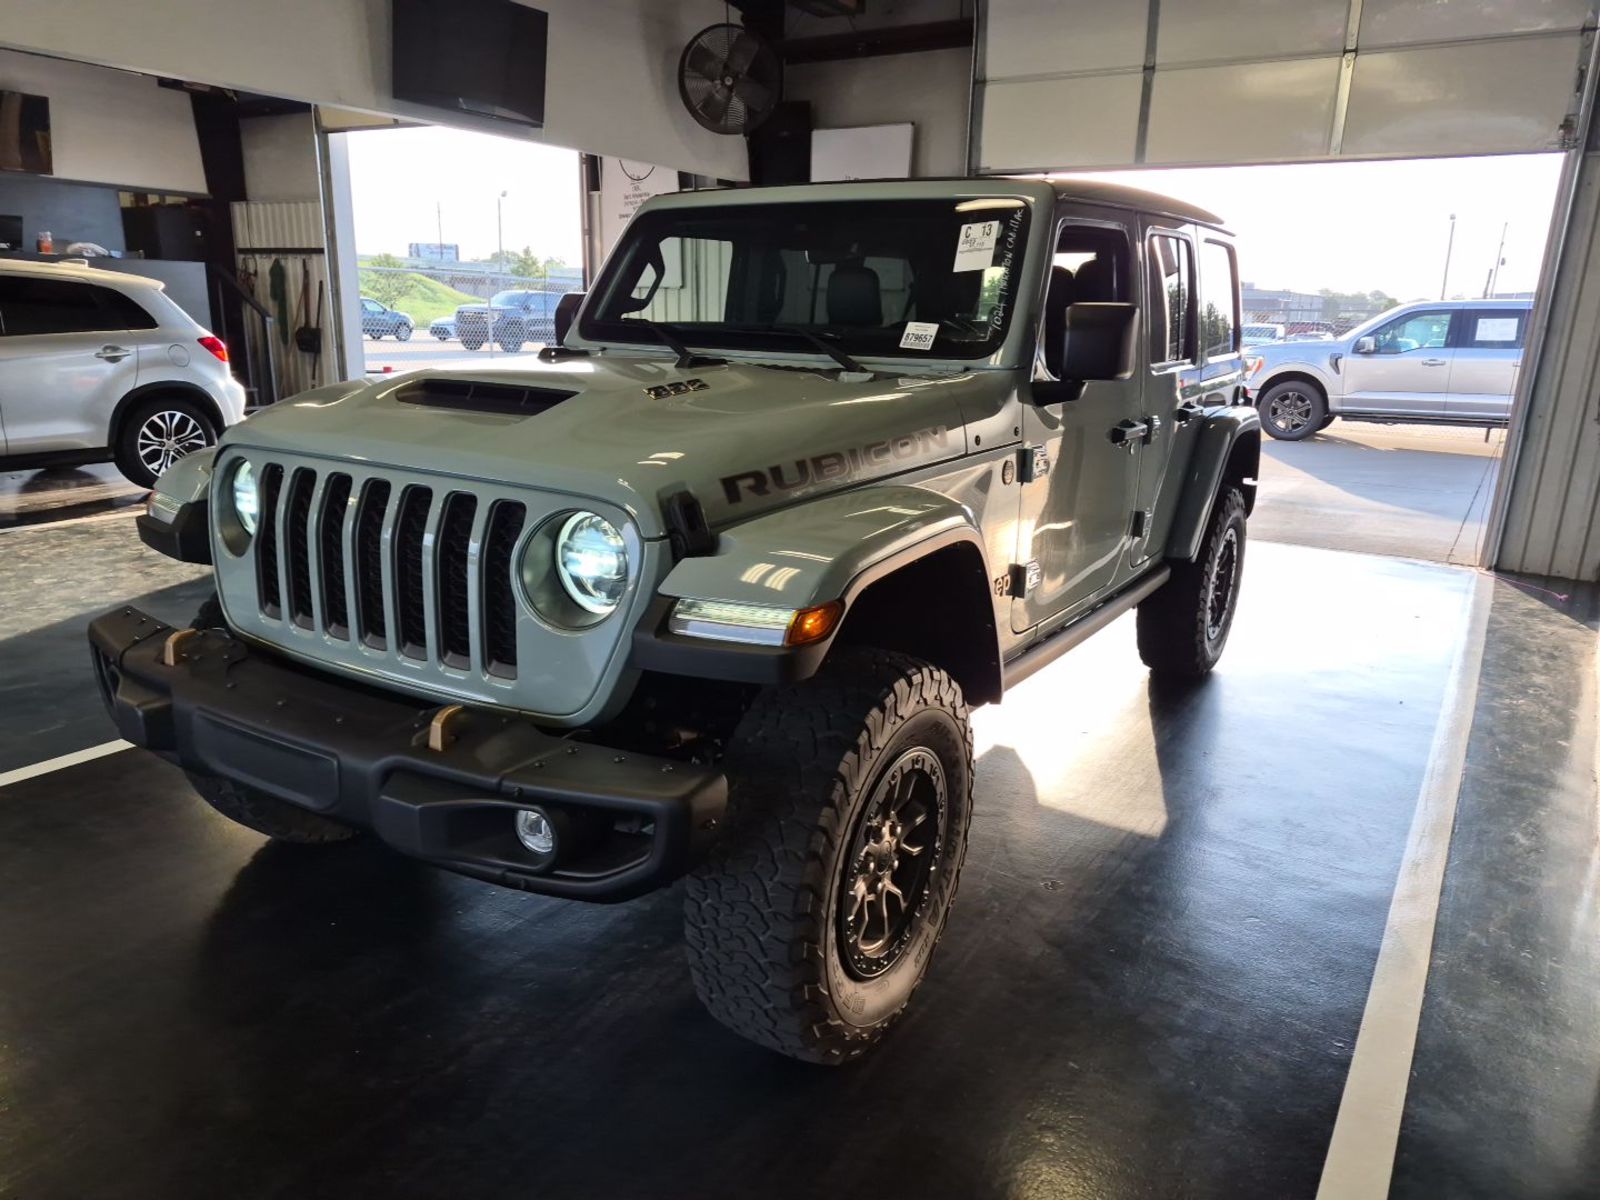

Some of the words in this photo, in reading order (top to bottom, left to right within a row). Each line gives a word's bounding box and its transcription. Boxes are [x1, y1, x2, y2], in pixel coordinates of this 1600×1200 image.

[964, 225, 972, 239] C
[981, 223, 993, 237] 13
[719, 425, 949, 505] RUBICON
